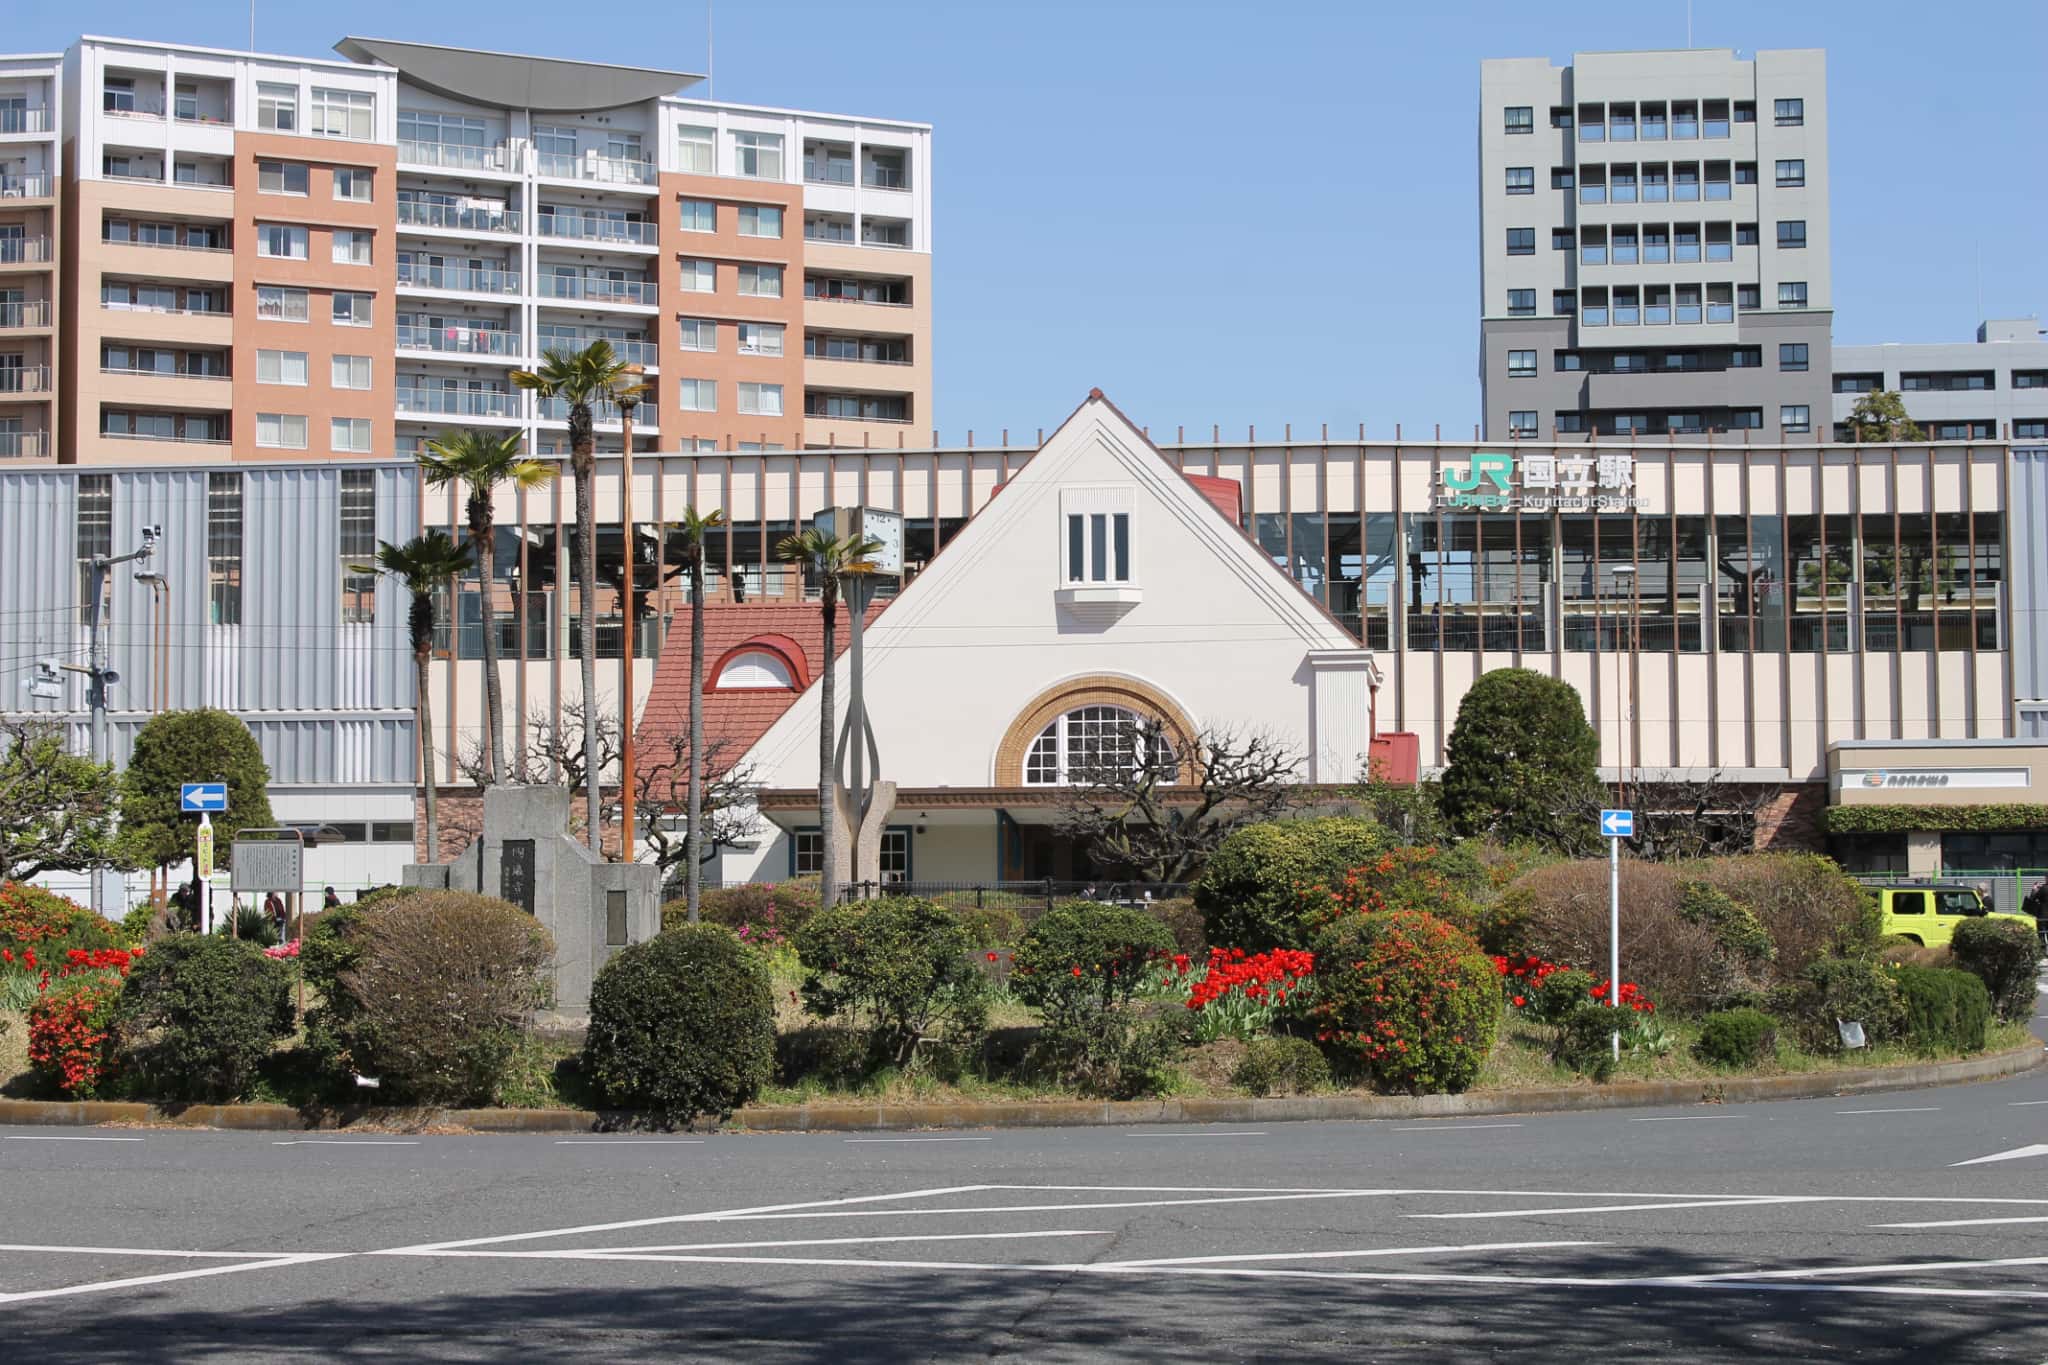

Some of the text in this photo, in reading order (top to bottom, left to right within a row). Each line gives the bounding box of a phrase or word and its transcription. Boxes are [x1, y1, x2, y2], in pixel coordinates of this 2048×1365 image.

[1445, 453, 1513, 491] JR
[1523, 454, 1633, 489] 国立駅
[1524, 495, 1649, 507] Kunitachi Station
